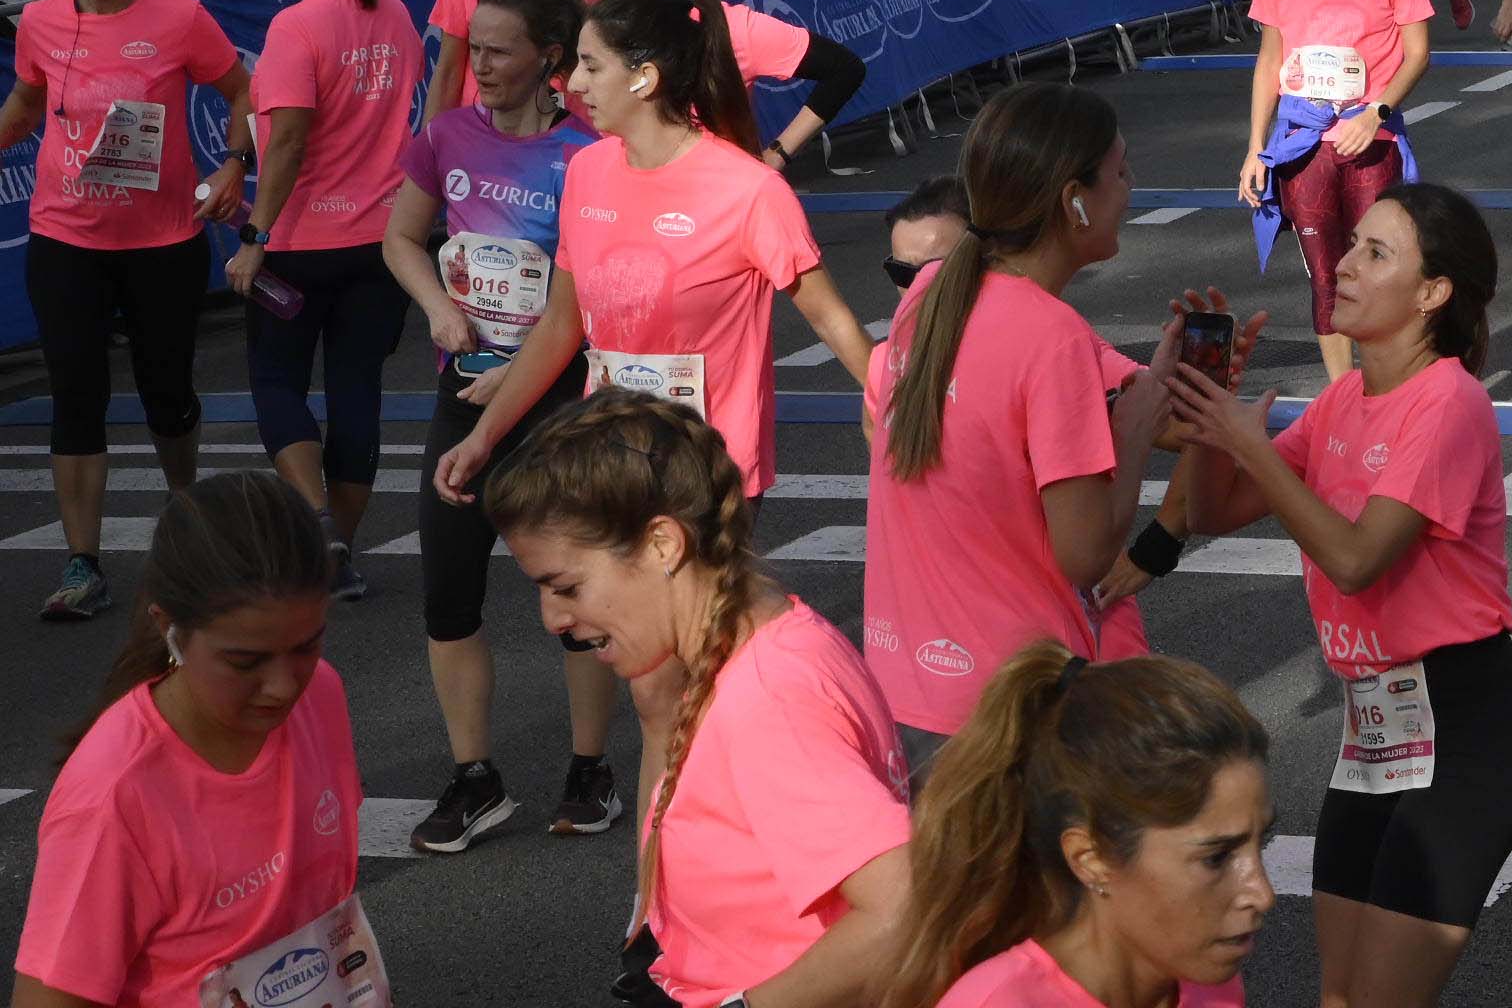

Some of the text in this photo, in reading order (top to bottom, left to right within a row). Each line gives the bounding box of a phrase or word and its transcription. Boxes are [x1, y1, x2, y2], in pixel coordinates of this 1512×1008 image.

[1308, 76, 1335, 87] 016
[63, 175, 130, 200] SUMA
[479, 180, 556, 213] ZURICH
[311, 201, 357, 212] OYSHO
[475, 252, 514, 266] ASTURIANA
[472, 277, 510, 295] 016
[476, 297, 503, 309] 29946
[495, 313, 517, 322] MUJER
[618, 373, 660, 387] ASTURIANA
[920, 648, 970, 671] ASTURIANA
[1381, 748, 1408, 759] MUJER
[215, 851, 288, 909] OYSHO
[329, 926, 356, 950] SUMA
[260, 959, 329, 1006] ASTURIANA
